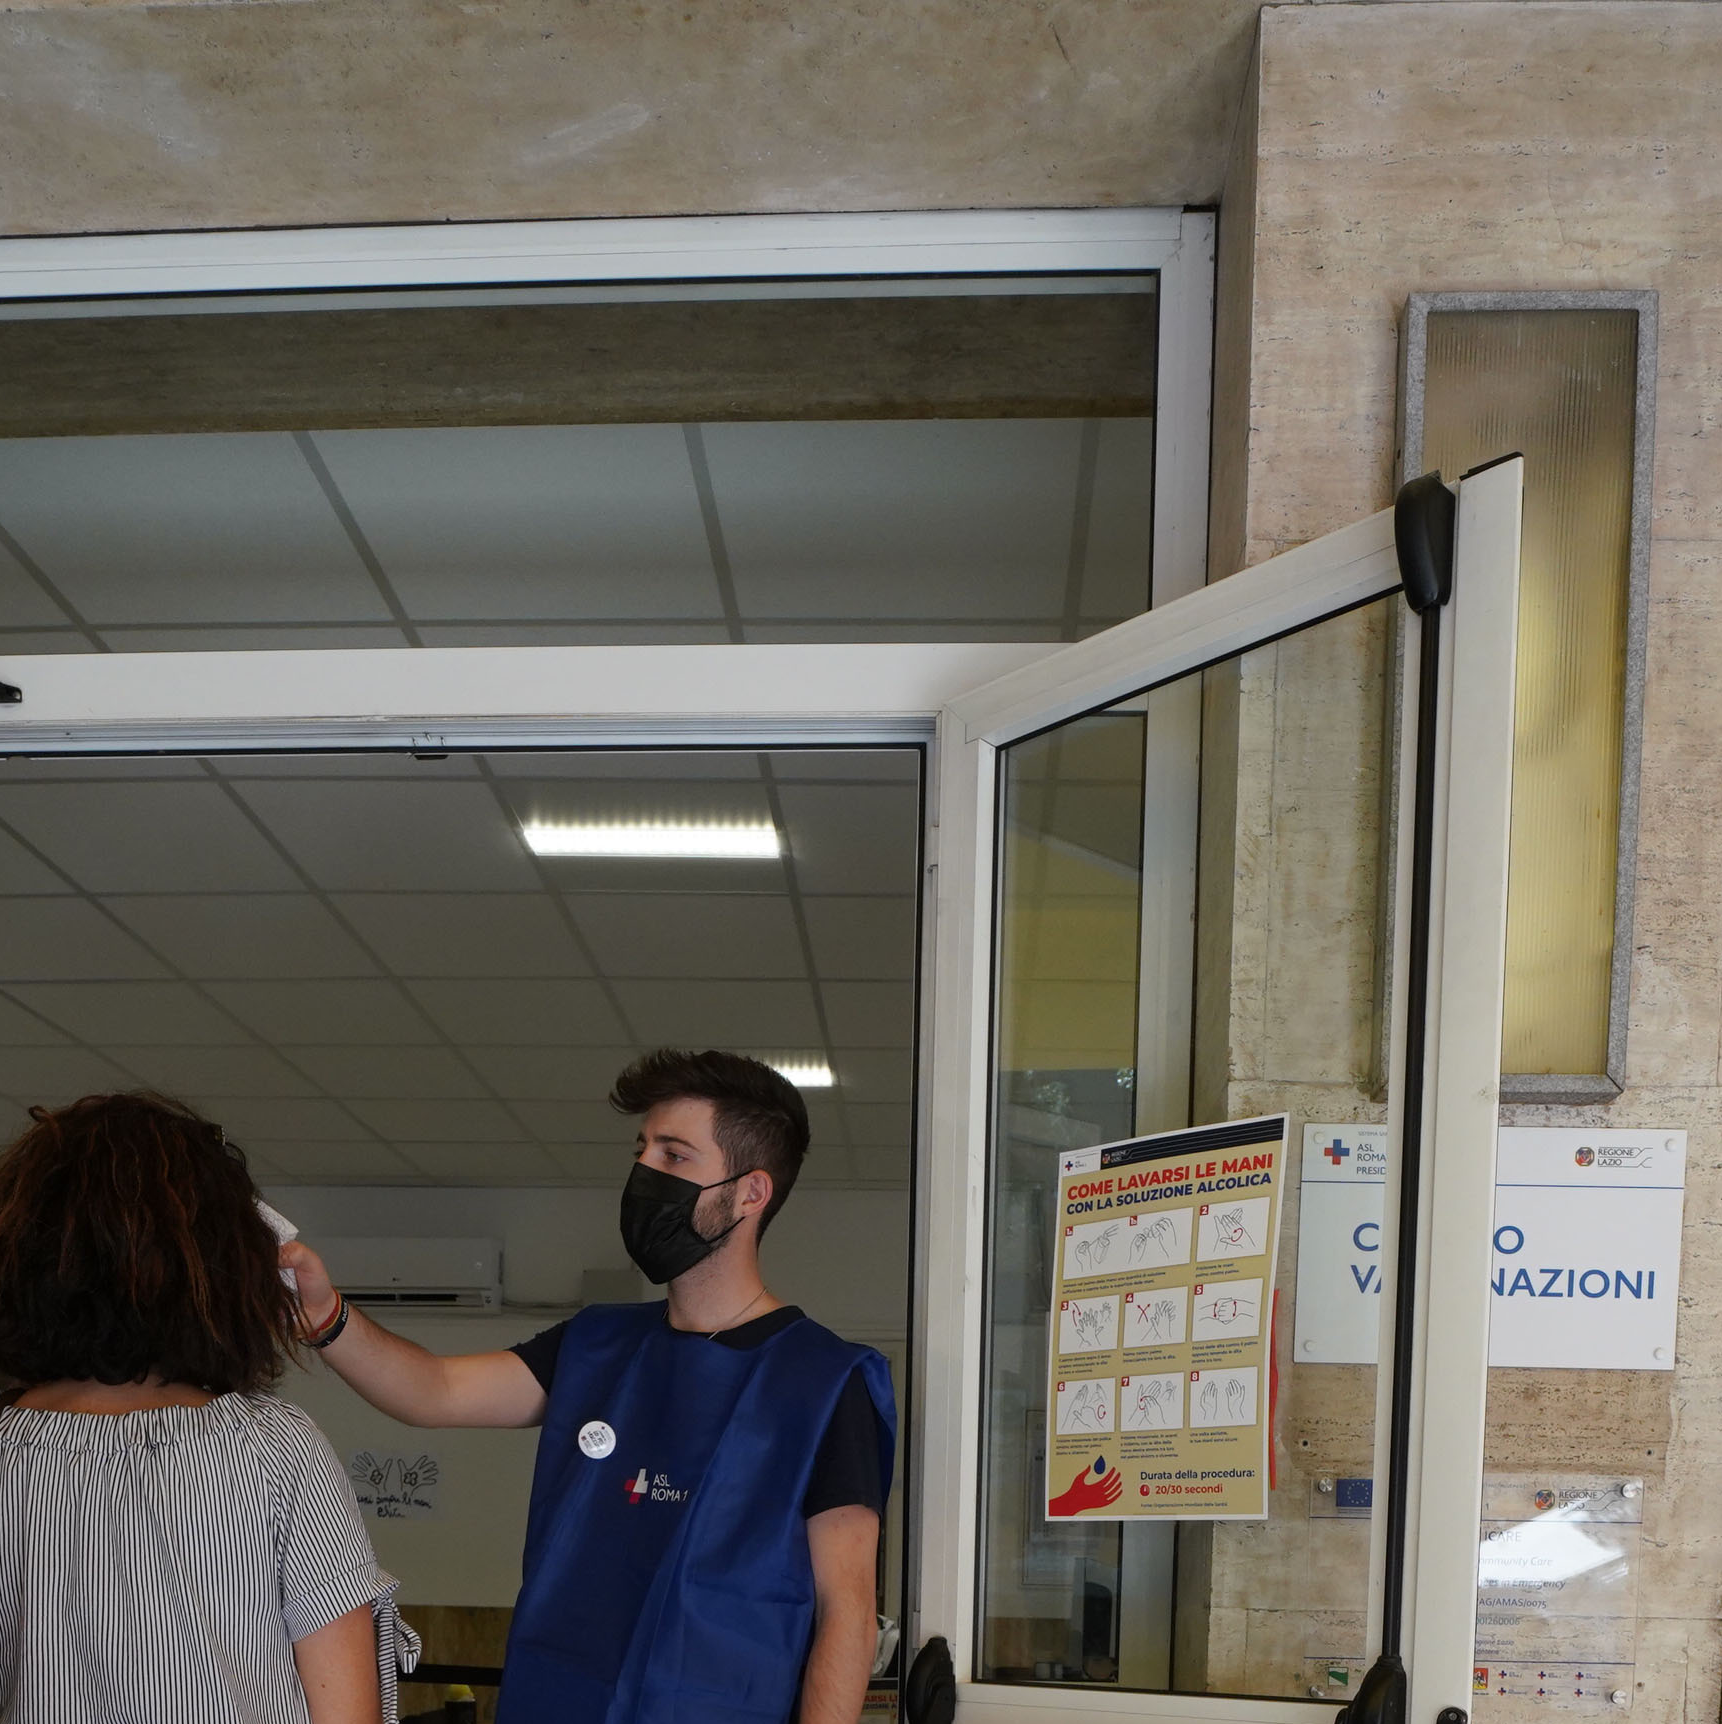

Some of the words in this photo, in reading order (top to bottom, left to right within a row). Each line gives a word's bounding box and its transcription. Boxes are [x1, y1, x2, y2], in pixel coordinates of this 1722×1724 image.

[1357, 1143, 1374, 1152] ASL
[1597, 1147, 1635, 1157] REGIONE
[1357, 1153, 1387, 1162] ROMA
[1597, 1158, 1623, 1167] LAZIO
[1356, 1166, 1387, 1175] PRESID
[1067, 1179, 1114, 1200] COME
[1118, 1166, 1190, 1191] LAVARSI
[1195, 1162, 1216, 1179] LE
[1221, 1153, 1273, 1174] MANI
[1066, 1200, 1093, 1215] CON
[1096, 1197, 1113, 1210] LA
[1116, 1184, 1193, 1206] SOLUZIONE
[1197, 1173, 1272, 1194] ALCOLICA
[1200, 1206, 1209, 1215] 2
[1351, 1264, 1655, 1299] VNAZIONI
[1195, 1285, 1203, 1294] 5
[1191, 1372, 1199, 1381] 8
[1140, 1471, 1172, 1480] Durata
[1175, 1469, 1198, 1479] della
[1200, 1468, 1255, 1480] procedura:
[653, 1474, 670, 1487] ASL
[1155, 1485, 1182, 1495] 20/30
[1184, 1484, 1223, 1494] secondi
[651, 1488, 680, 1502] ROMA
[682, 1490, 689, 1502] 1
[1558, 1491, 1598, 1500] REGIONE
[1558, 1502, 1585, 1510] LAZO
